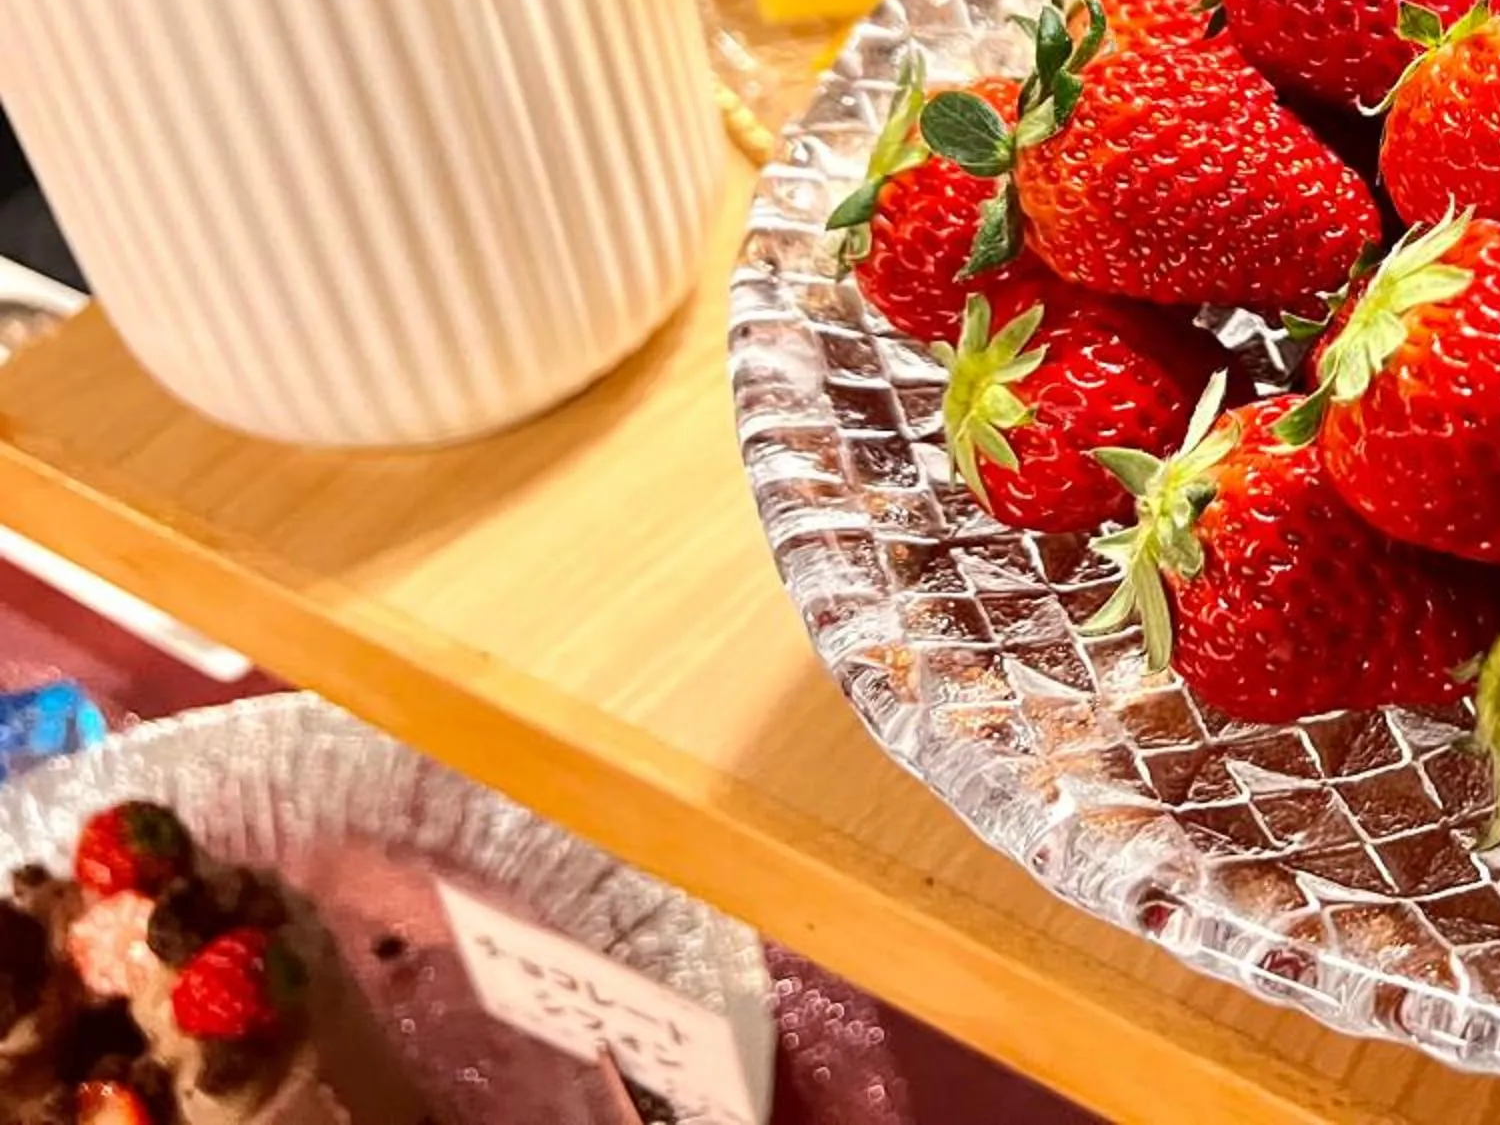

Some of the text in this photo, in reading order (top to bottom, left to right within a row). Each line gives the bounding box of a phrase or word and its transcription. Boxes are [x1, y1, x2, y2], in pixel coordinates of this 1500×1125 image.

[475, 934, 690, 1046] チョコレート
